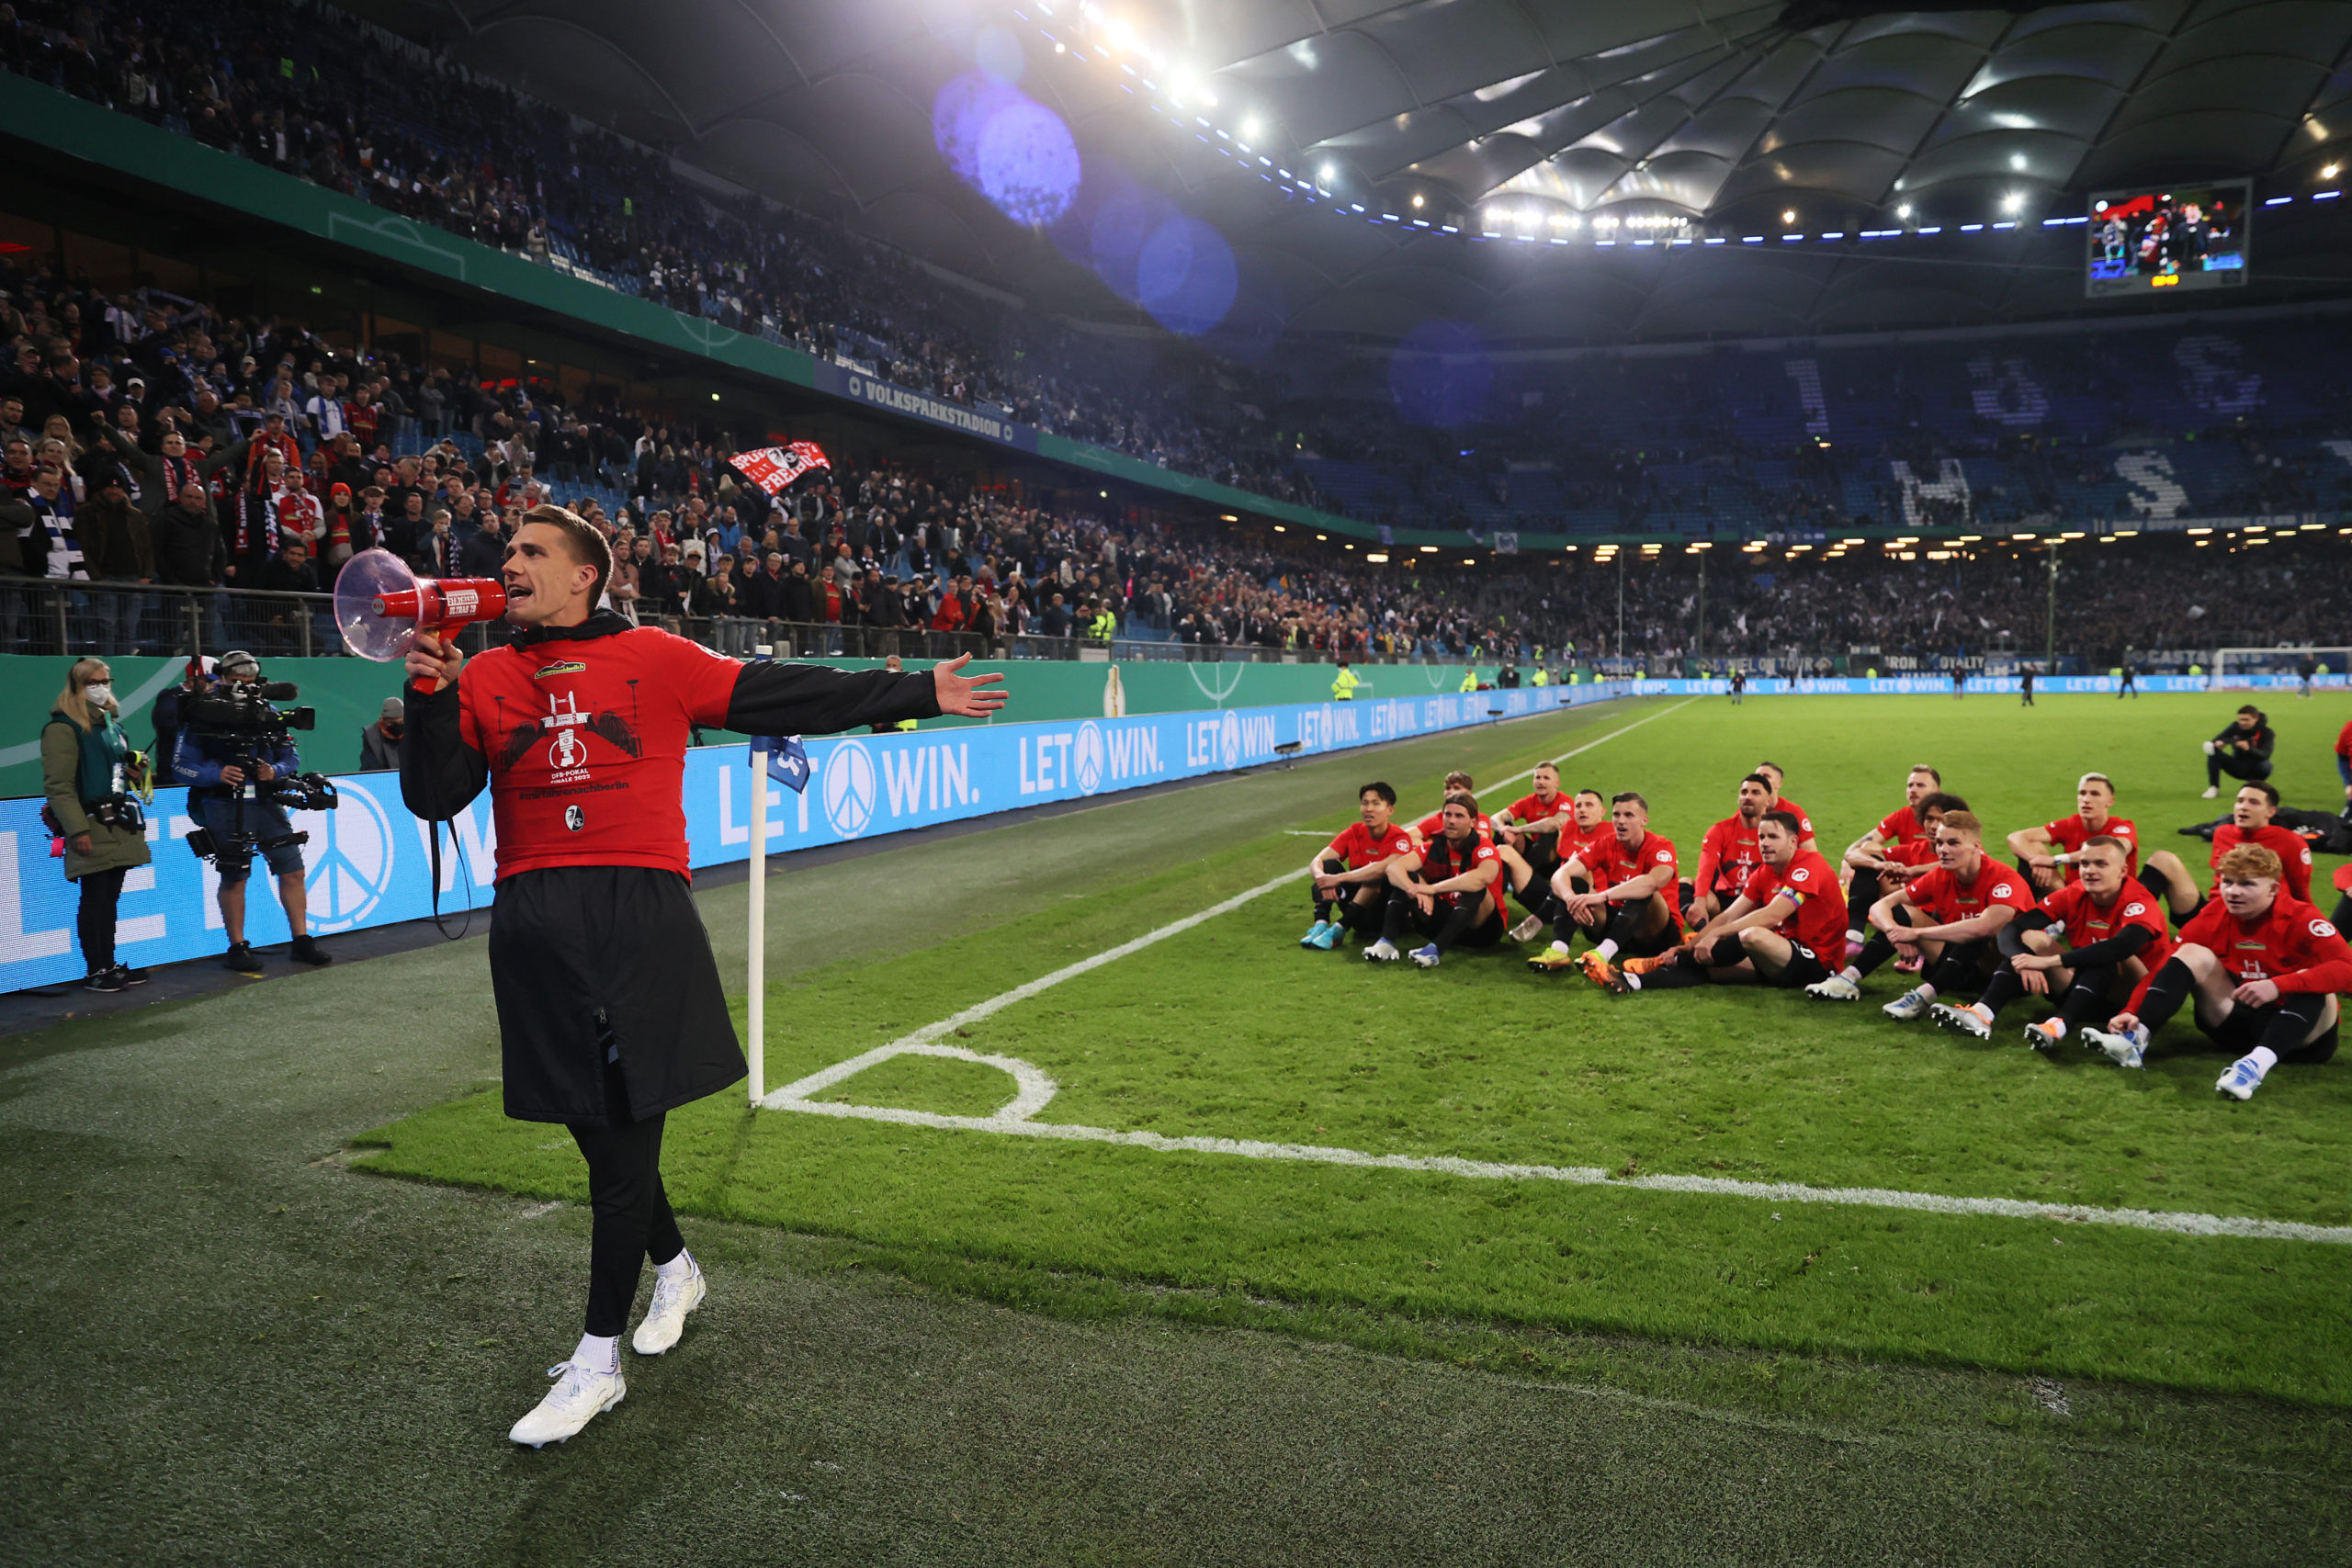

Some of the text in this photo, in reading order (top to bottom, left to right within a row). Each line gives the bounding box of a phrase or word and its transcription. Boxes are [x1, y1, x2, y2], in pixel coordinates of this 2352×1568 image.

[865, 381, 1001, 438] VOLKSPARKSTADION
[1686, 681, 1711, 693] LET
[1817, 680, 1850, 693] WIN.
[1871, 680, 1949, 692] LET WIN.
[1967, 679, 2049, 692] LET WN.
[2111, 678, 2151, 691] WN.
[1297, 708, 1360, 748] LET WIN.
[1371, 705, 1387, 737] LET
[1187, 720, 1220, 768] LET
[1019, 726, 1164, 795] LET WIN.
[551, 768, 589, 780] DFB-POKAL
[882, 742, 980, 818] WIN.
[519, 781, 629, 800] #mirfahrenachberlin
